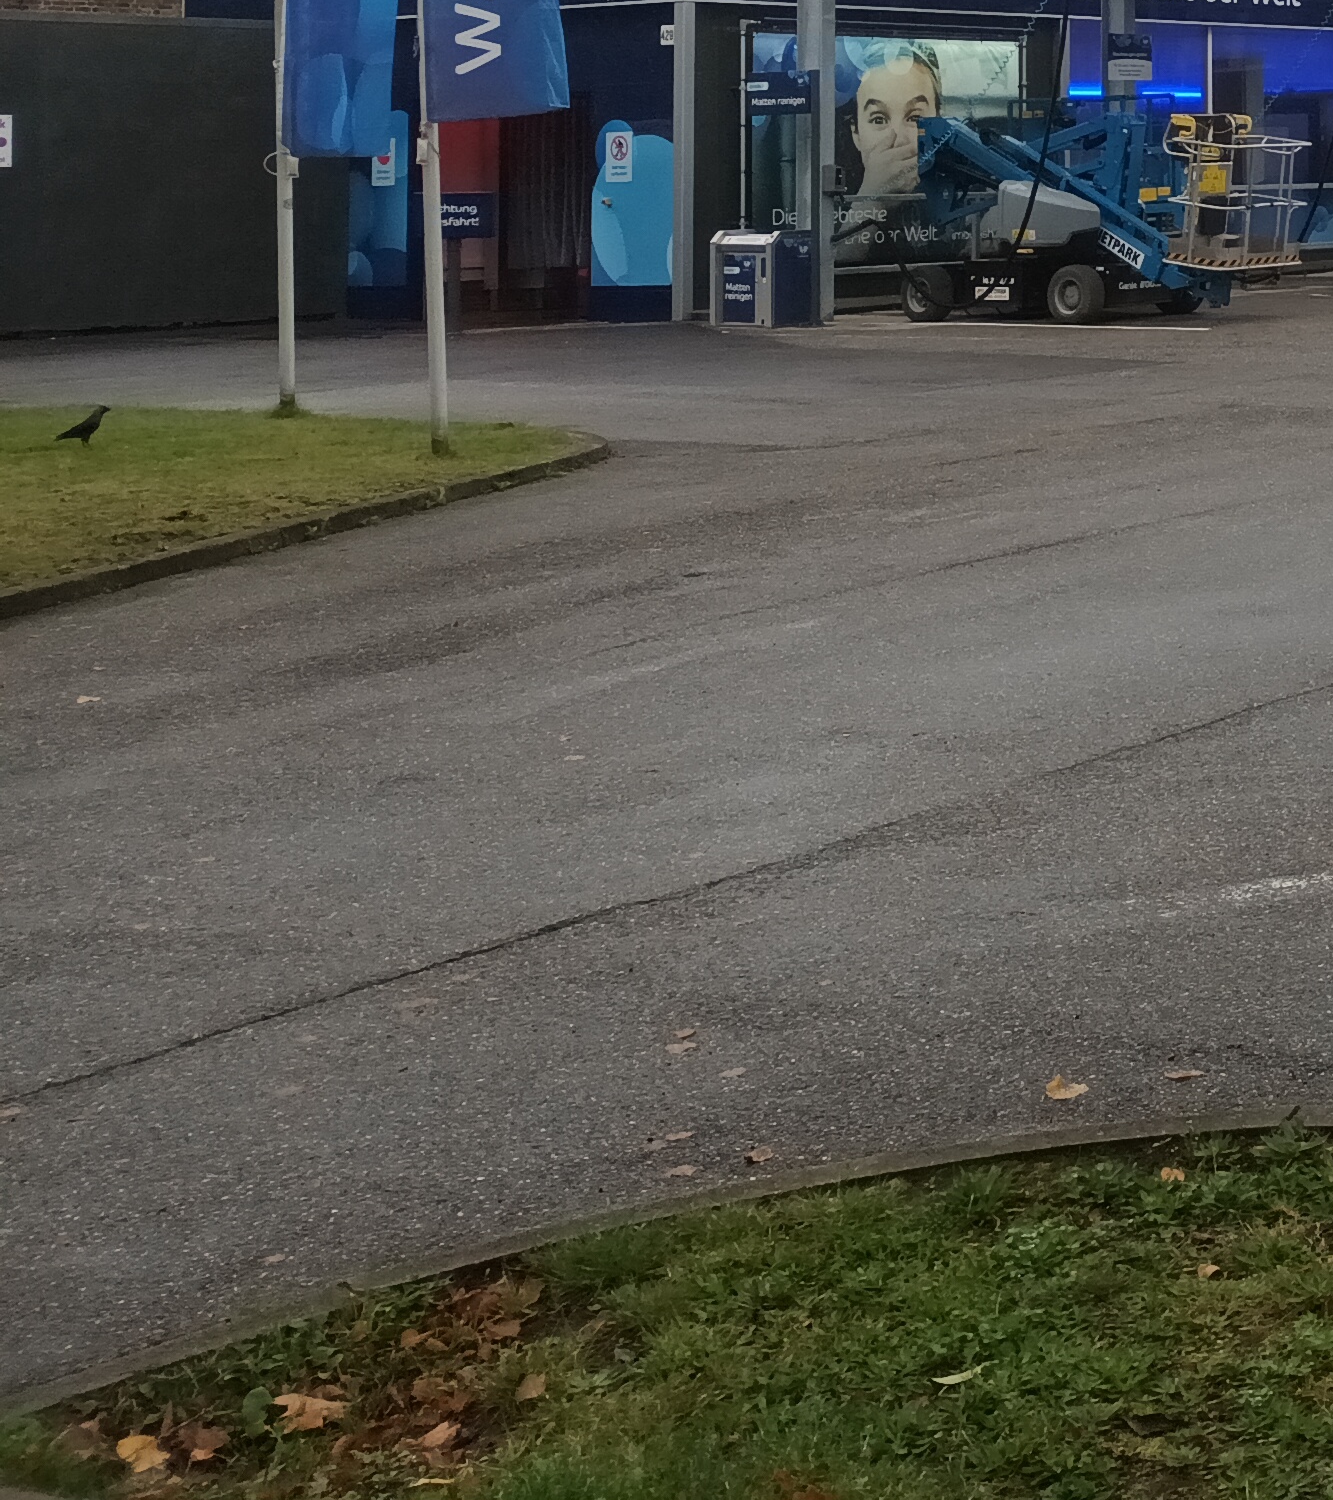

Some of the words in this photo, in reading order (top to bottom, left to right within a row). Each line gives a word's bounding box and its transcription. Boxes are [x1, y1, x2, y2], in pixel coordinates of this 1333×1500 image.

[440, 204, 478, 215] chtung
[903, 224, 938, 242] Welt
[1101, 230, 1141, 266] ETPARK
[725, 282, 751, 292] Matten
[724, 291, 753, 302] reinigen
